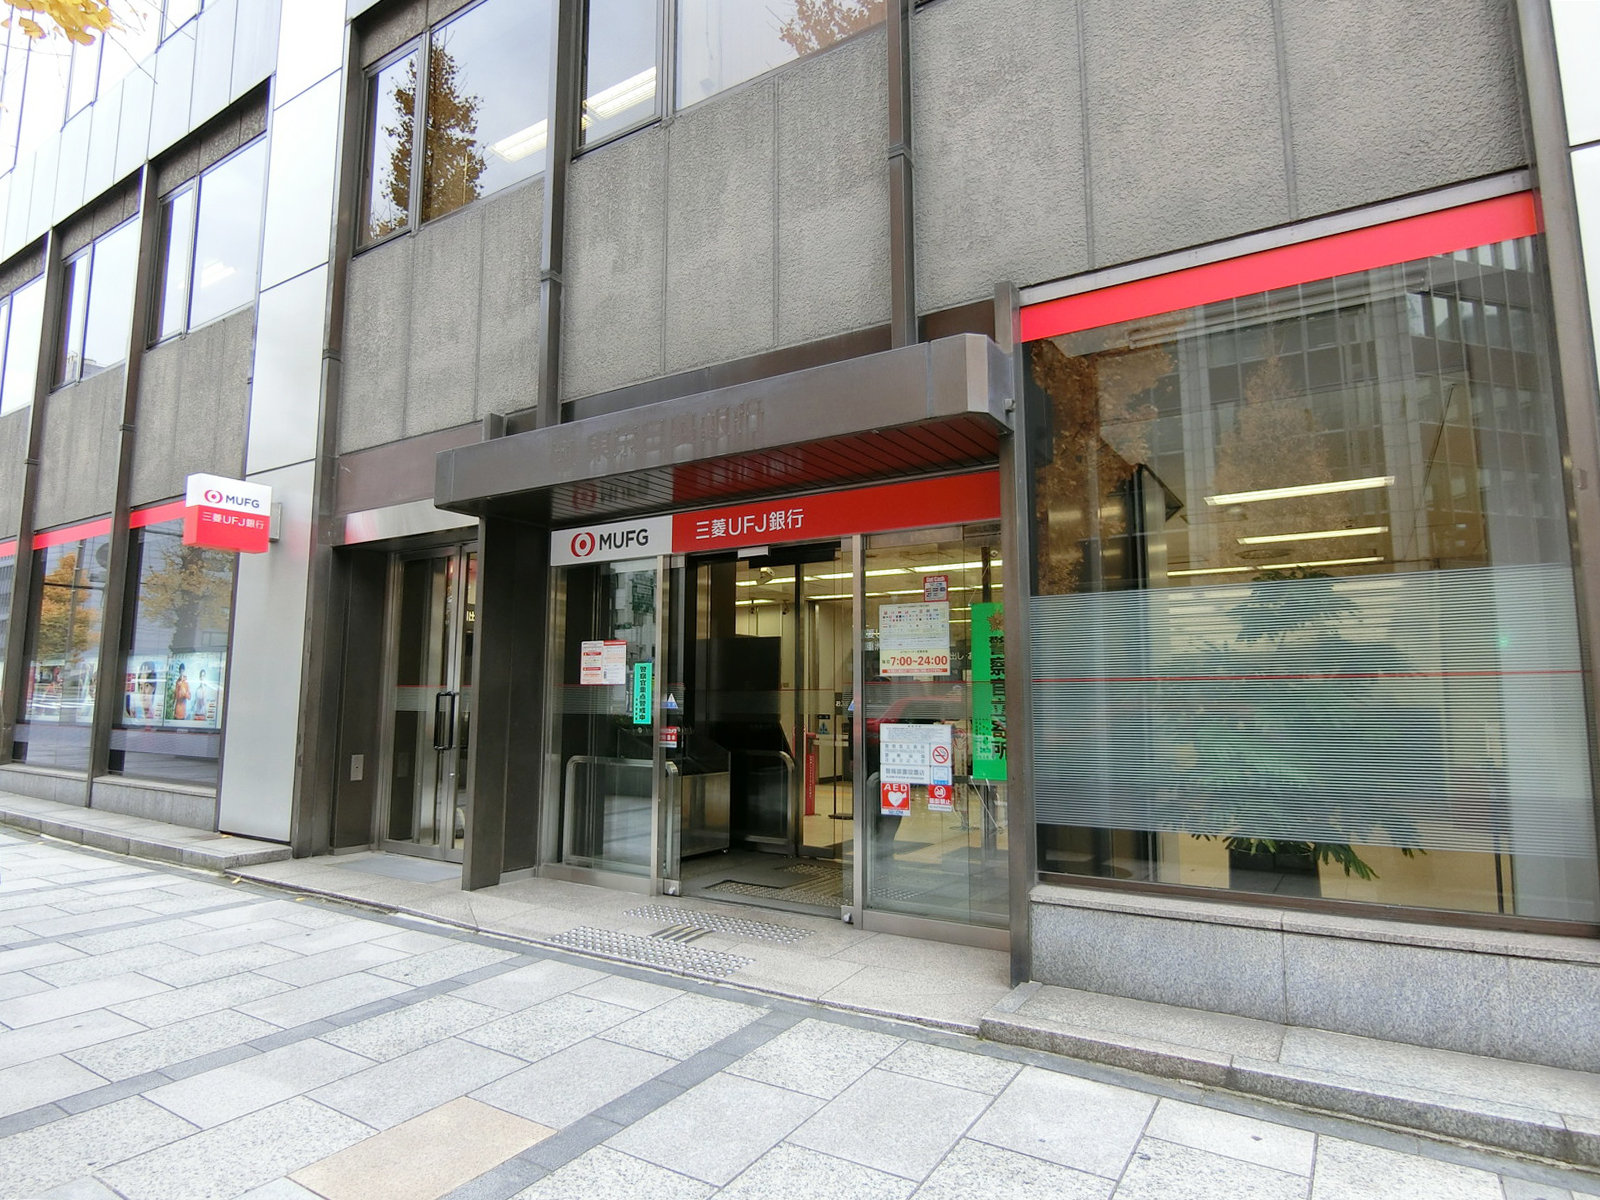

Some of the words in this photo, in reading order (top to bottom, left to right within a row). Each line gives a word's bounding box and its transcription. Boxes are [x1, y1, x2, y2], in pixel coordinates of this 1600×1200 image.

[225, 494, 260, 509] MUFG
[202, 511, 265, 530] 三菱UFJ銀行
[695, 508, 804, 540] 三菱UFJ銀行
[599, 529, 649, 551] MUFG
[884, 783, 908, 791] AED
